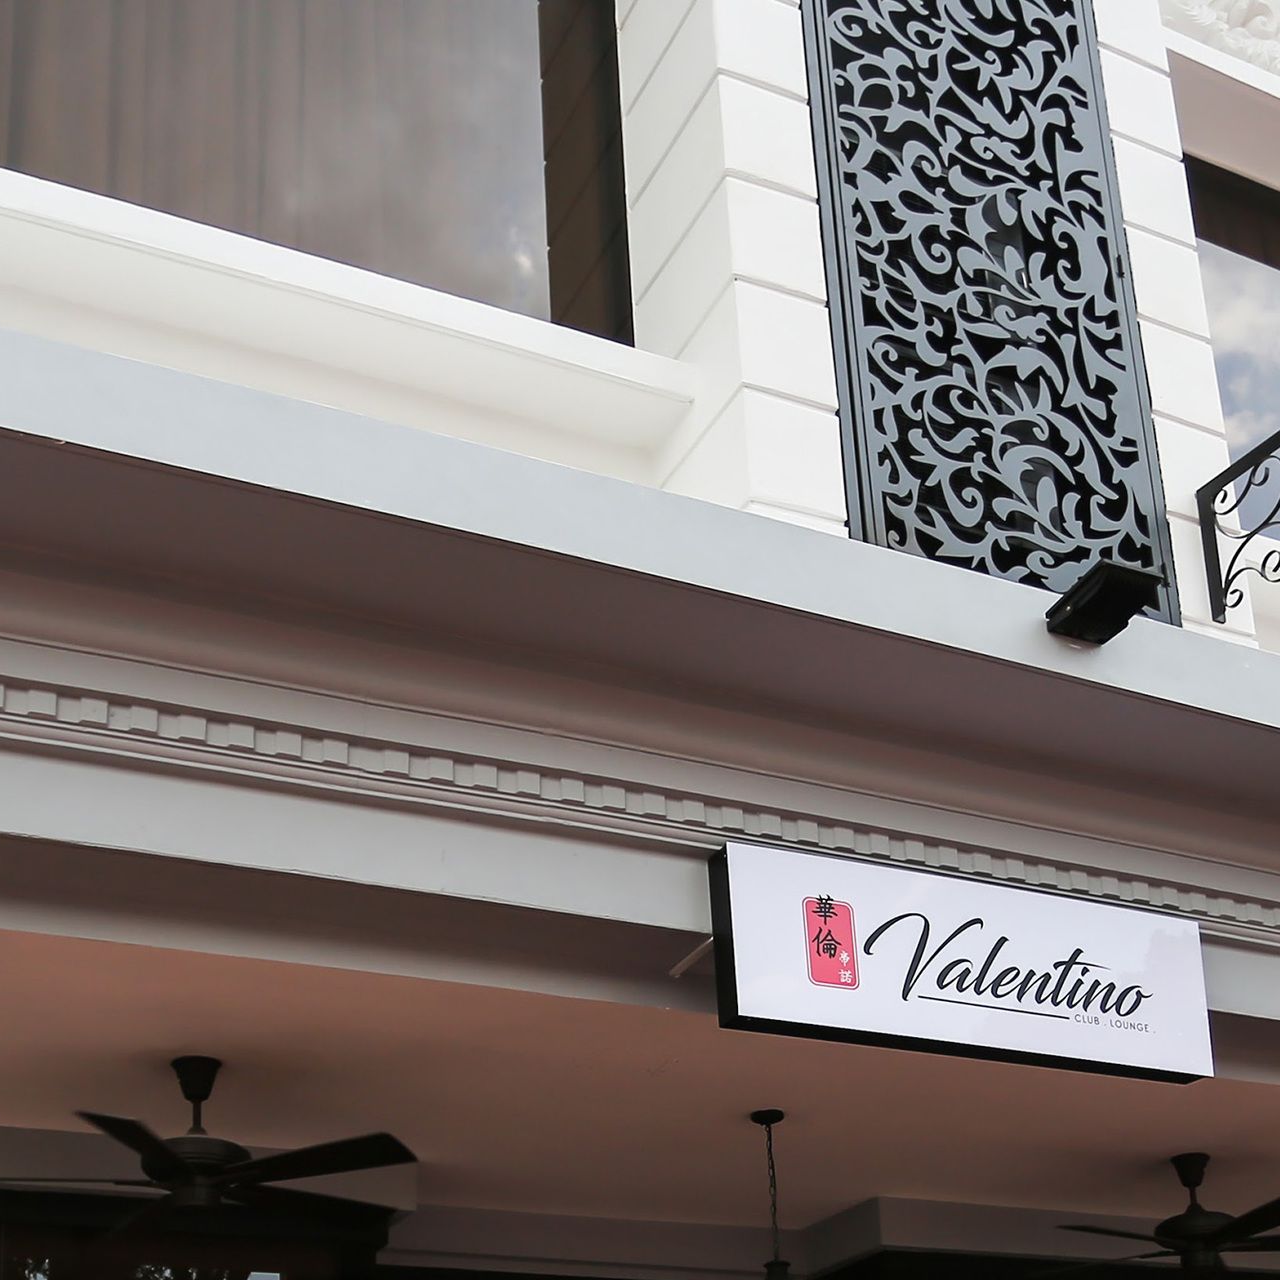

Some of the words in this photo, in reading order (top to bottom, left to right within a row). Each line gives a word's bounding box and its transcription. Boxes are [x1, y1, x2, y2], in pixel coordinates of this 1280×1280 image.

[811, 894, 842, 960] 華倫
[863, 912, 1154, 1017] Valentino
[1074, 1013, 1101, 1026] CLUB
[1109, 1018, 1150, 1033] LOUNGE
